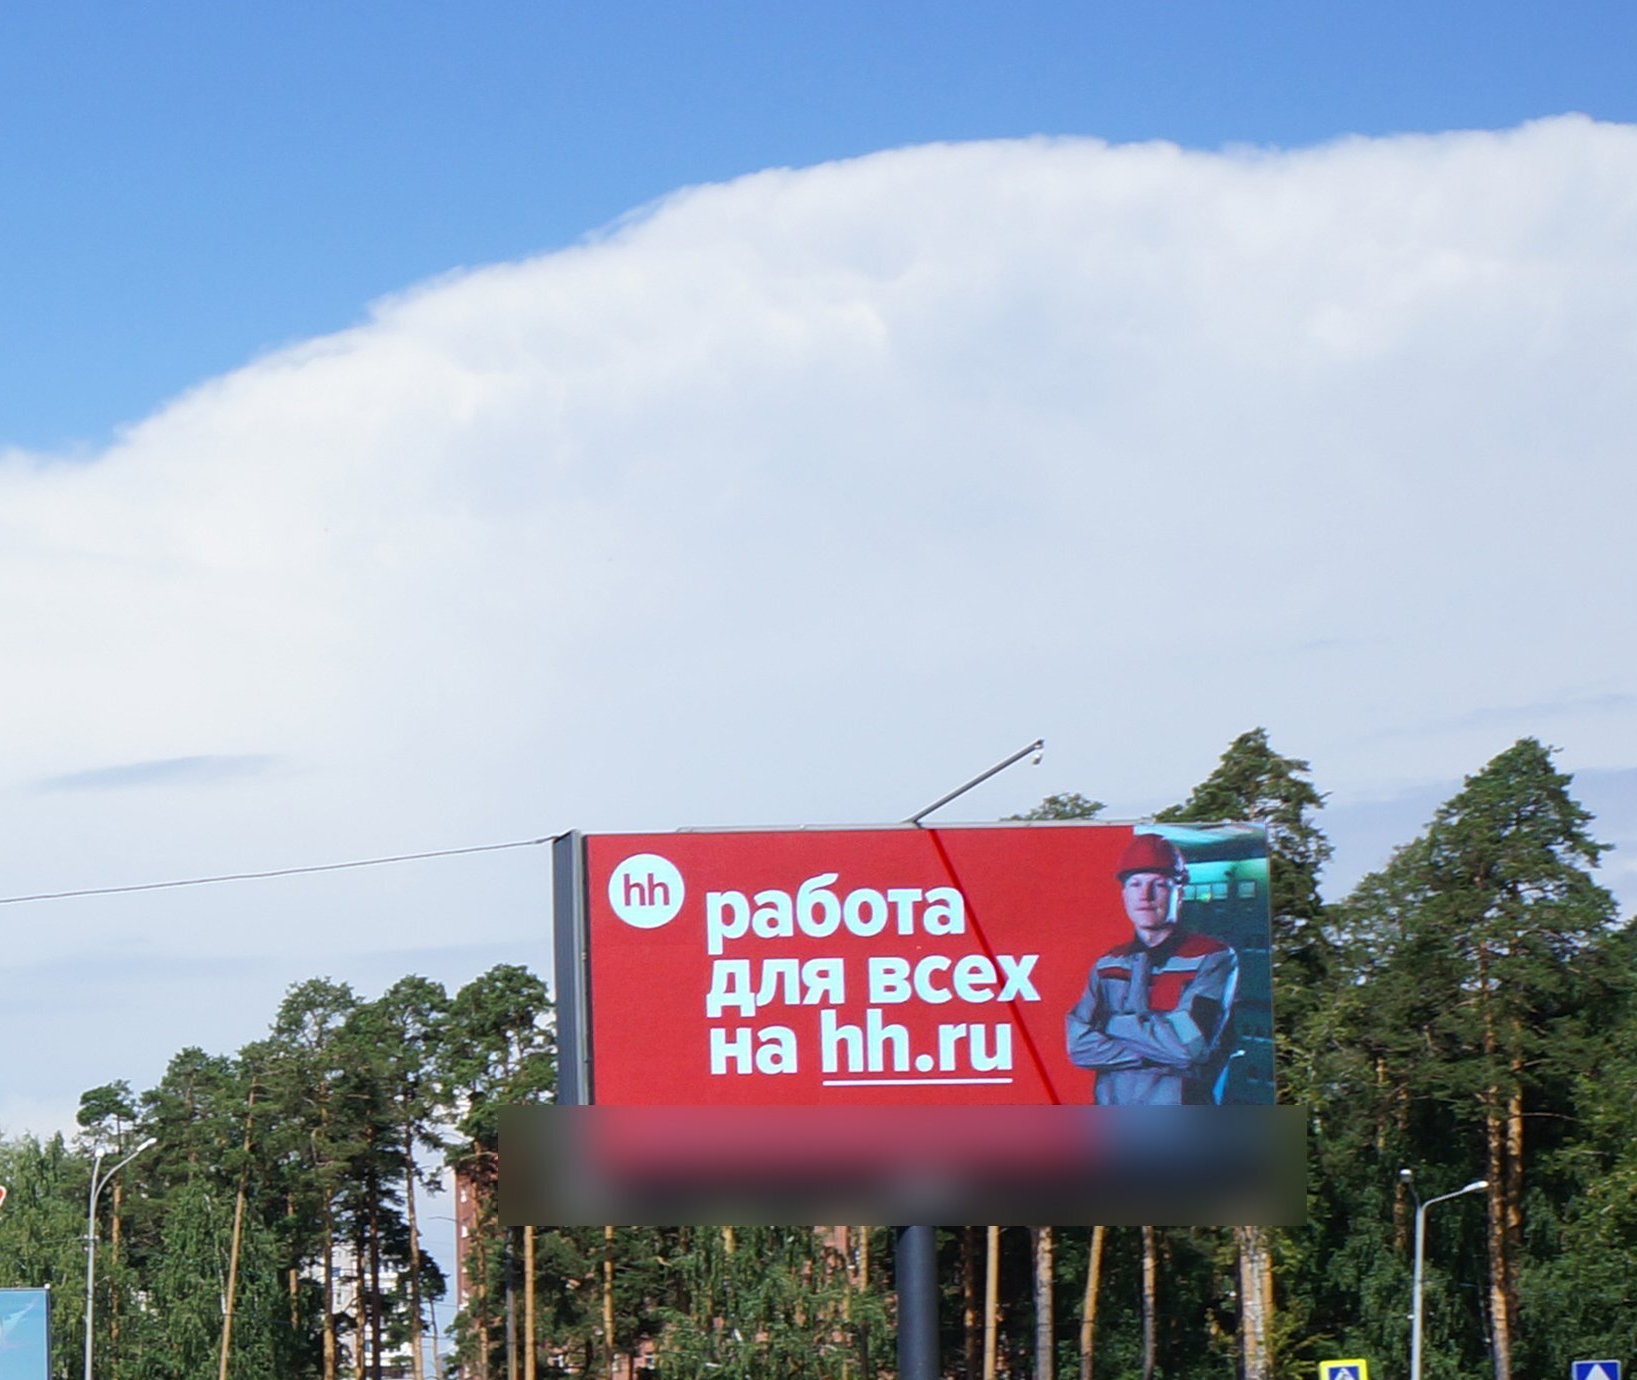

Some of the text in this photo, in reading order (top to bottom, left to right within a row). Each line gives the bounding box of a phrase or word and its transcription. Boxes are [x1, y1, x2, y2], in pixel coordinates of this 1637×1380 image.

[623, 874, 671, 908] hh
[706, 873, 966, 955] работа
[706, 954, 1041, 1018] для всех
[710, 1009, 1014, 1076] на hh.ru
